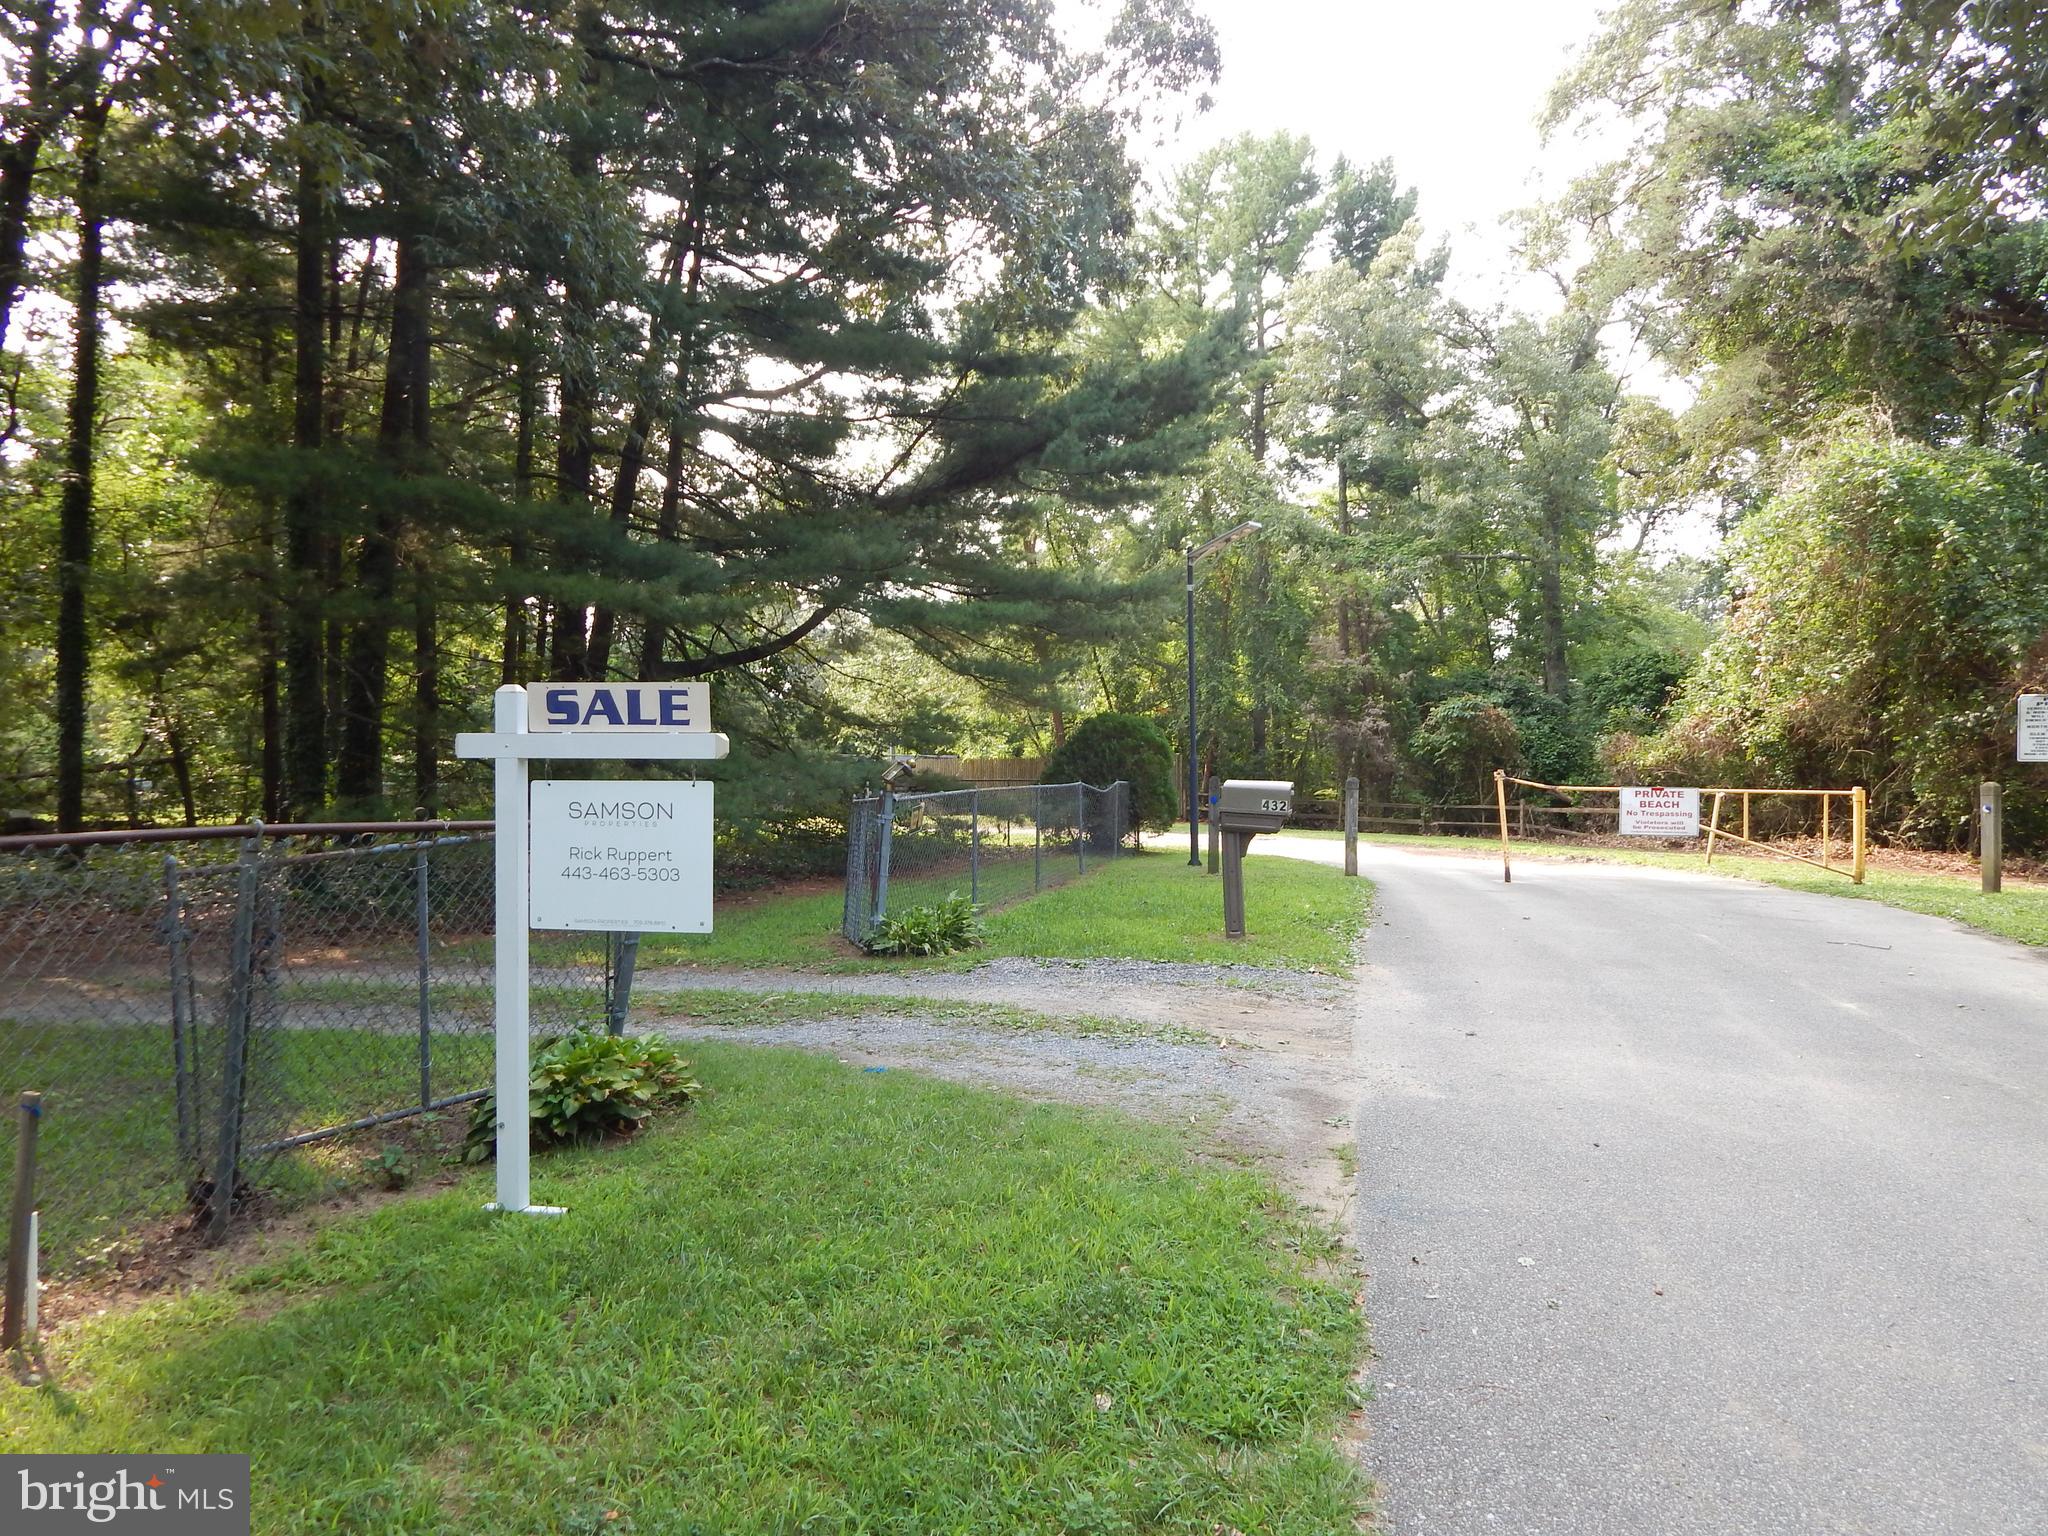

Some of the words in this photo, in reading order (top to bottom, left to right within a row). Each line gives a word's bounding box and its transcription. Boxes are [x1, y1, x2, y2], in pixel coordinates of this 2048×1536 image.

[546, 689, 690, 725] SALE
[1634, 790, 1685, 798] PRIVATE
[568, 801, 673, 820] SAMSON
[1262, 800, 1287, 811] 432
[1641, 810, 1693, 818] Trespassing
[584, 820, 658, 828] PROPERTIES
[569, 846, 602, 861] Rick
[607, 847, 672, 866] Ruppert
[561, 866, 680, 881] 443-463-5303
